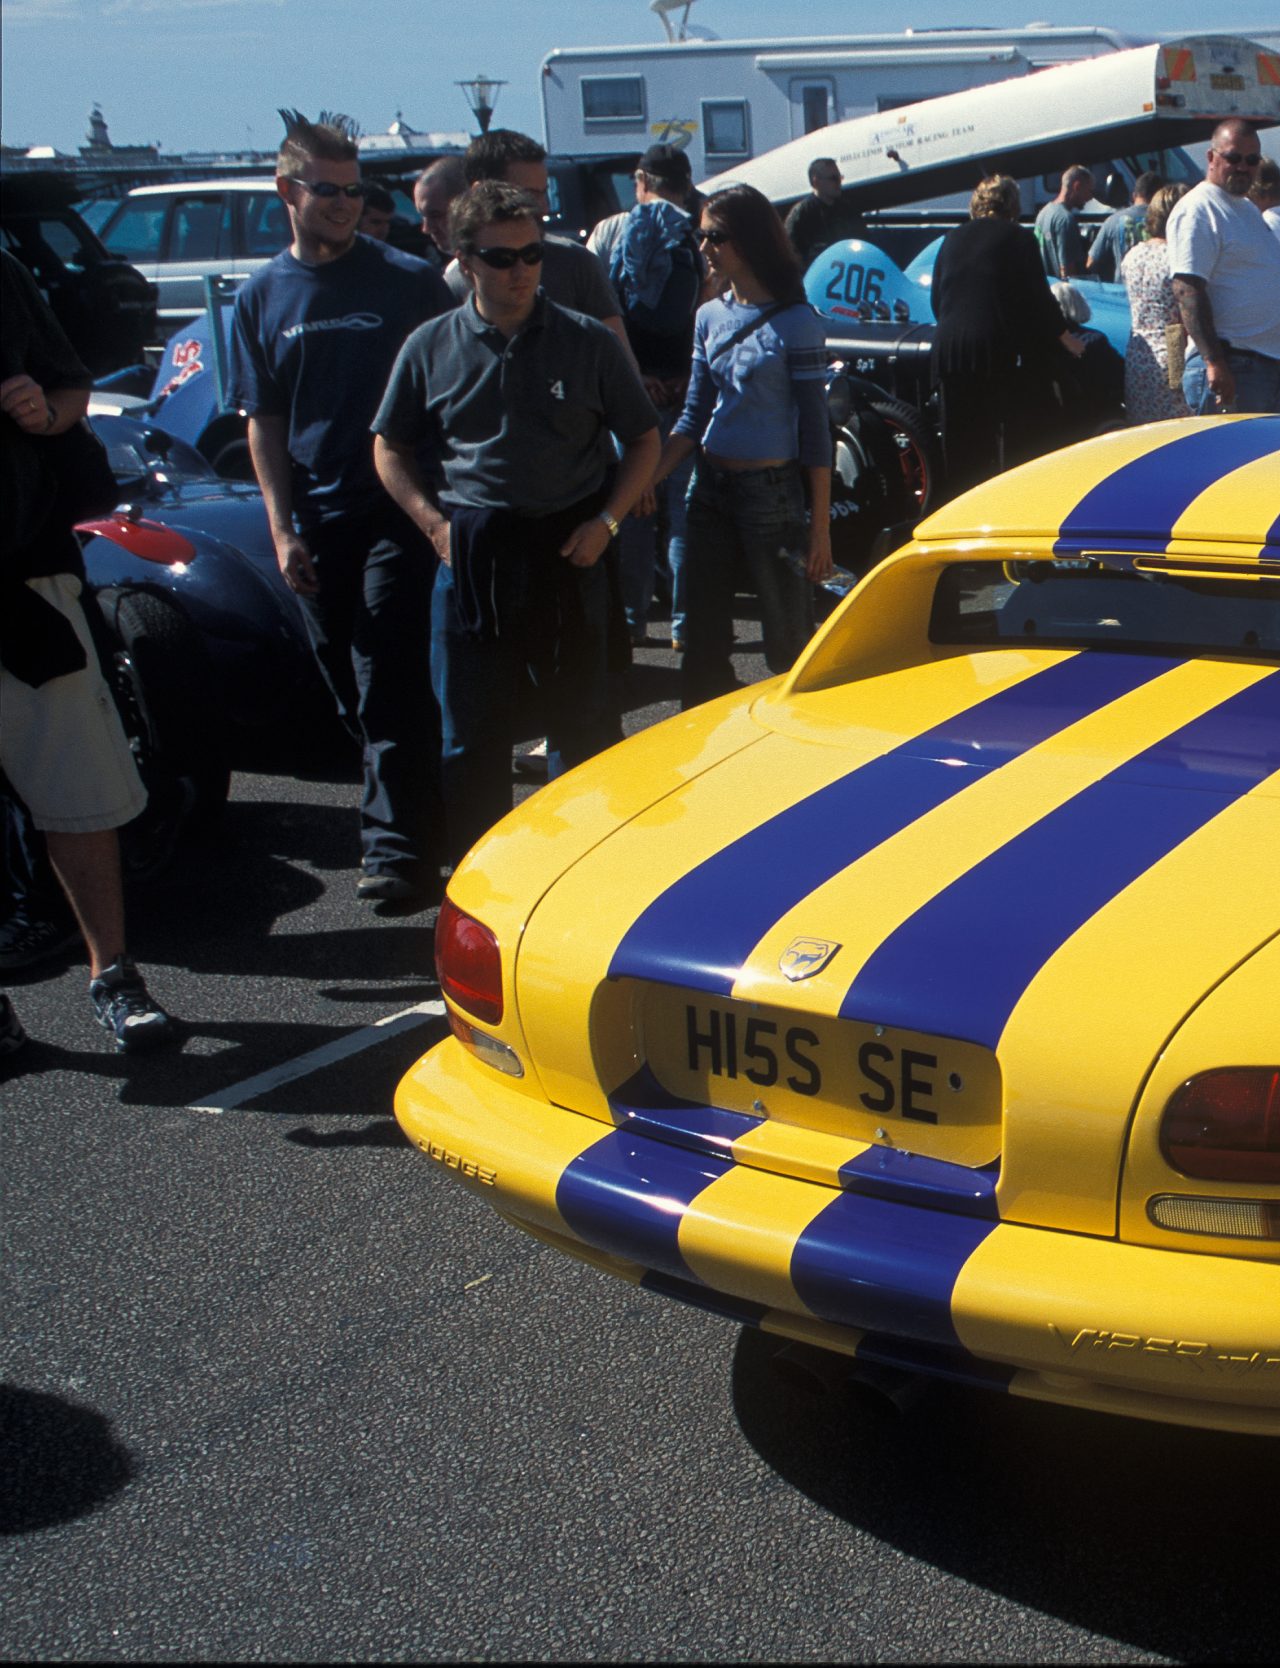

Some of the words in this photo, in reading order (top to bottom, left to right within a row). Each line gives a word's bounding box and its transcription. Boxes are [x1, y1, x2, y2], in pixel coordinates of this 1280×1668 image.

[917, 132, 949, 146] RACING
[952, 124, 975, 137] TEAM
[825, 260, 886, 305] 206
[858, 1041, 939, 1126] SE
[417, 1134, 497, 1186] DODGE
